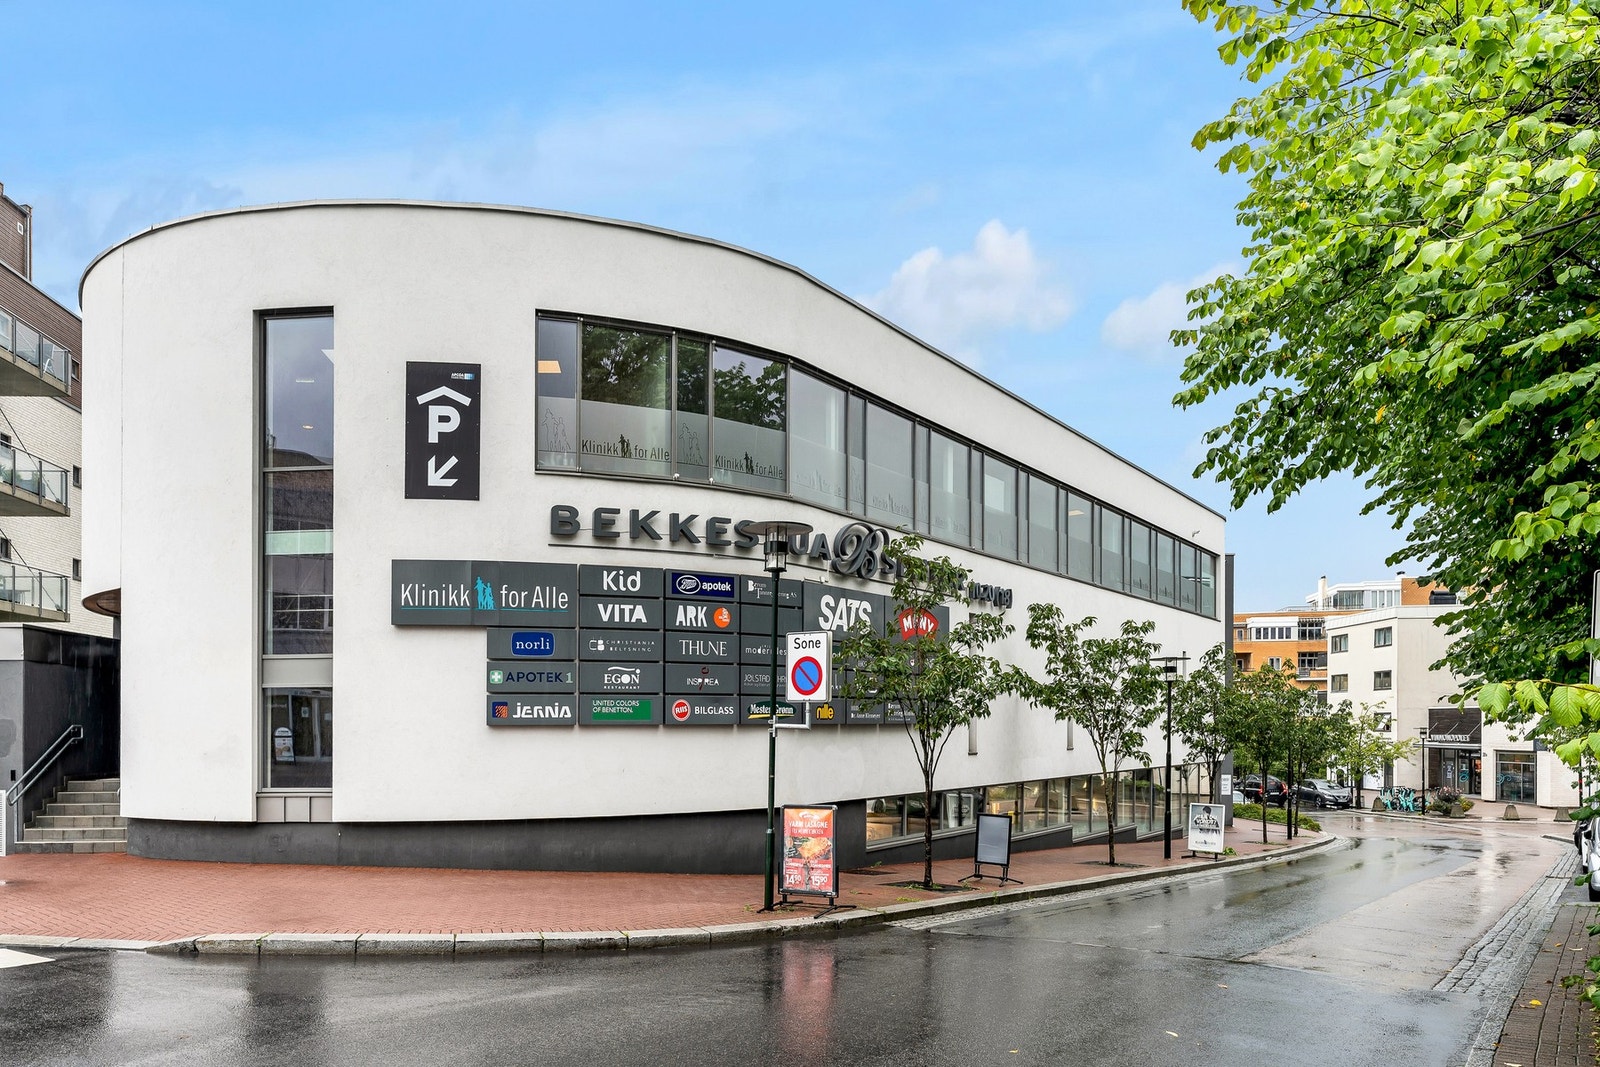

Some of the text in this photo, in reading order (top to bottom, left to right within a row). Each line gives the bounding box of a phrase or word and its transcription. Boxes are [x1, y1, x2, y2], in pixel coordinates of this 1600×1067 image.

[428, 405, 461, 443] P
[582, 439, 670, 461] Klinikk for Alle
[715, 455, 783, 478] Klinikk for Alle
[550, 504, 831, 560] BEKKESUA
[603, 570, 641, 592] Kid
[702, 582, 731, 591] apotek
[401, 583, 569, 609] Klinikk for Alle
[597, 603, 648, 623] VITA
[675, 605, 707, 627] ARK
[818, 594, 872, 635] SATS
[516, 638, 550, 650] norli
[679, 640, 728, 656] THUNE
[793, 637, 821, 650] Sone
[505, 671, 573, 684] APOTEK 1
[604, 673, 640, 684] EGON
[694, 706, 734, 715] BILGLASS
